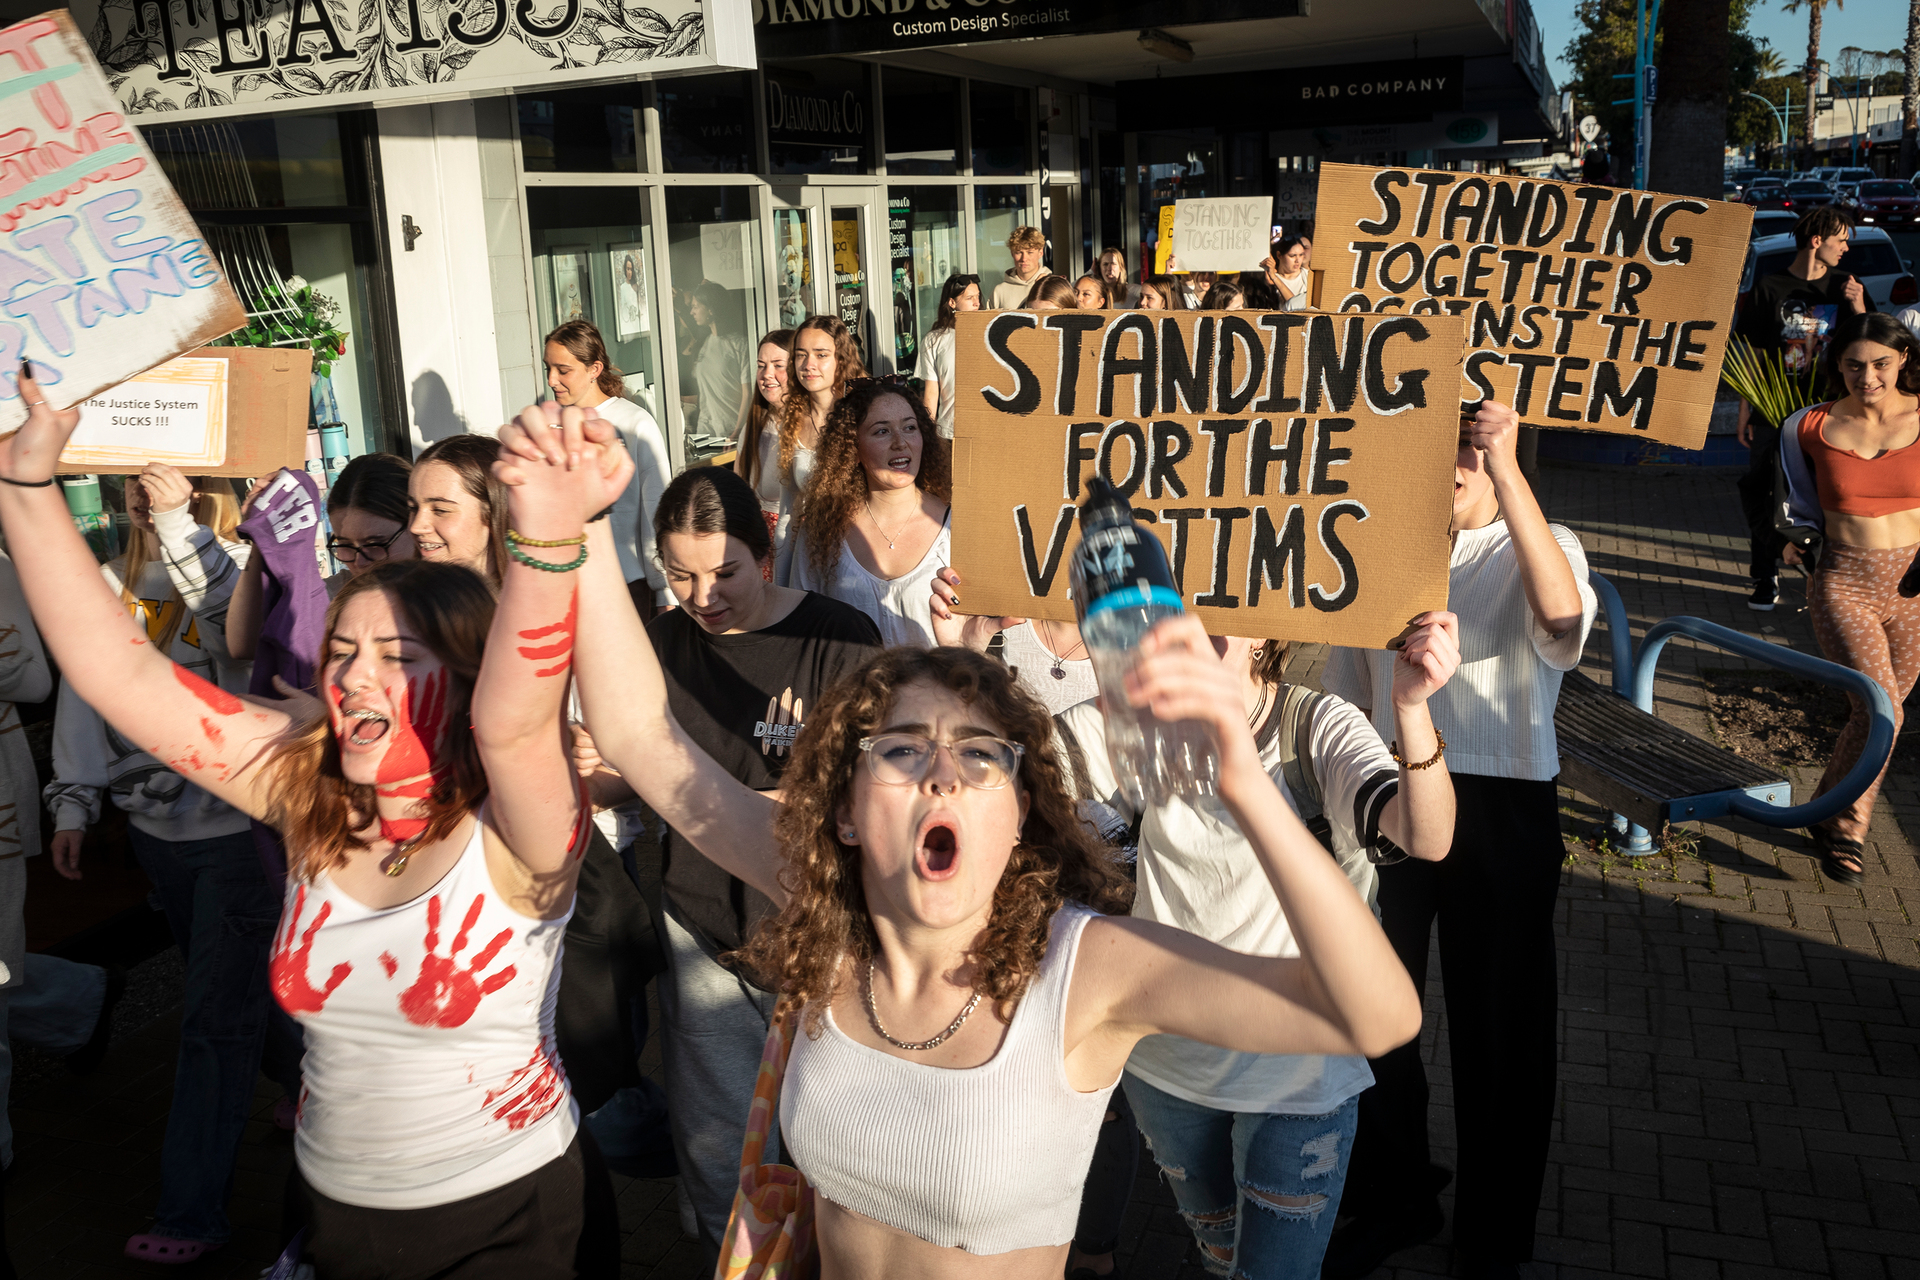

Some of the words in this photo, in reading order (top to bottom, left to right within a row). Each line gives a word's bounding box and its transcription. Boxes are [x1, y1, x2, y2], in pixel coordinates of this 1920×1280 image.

[893, 21, 946, 36] Custom
[950, 15, 998, 32] Design
[1001, 8, 1070, 29] Specialist
[1302, 85, 1339, 99] BAD
[1347, 77, 1446, 96] COMPANY
[768, 79, 830, 133] DIAMOND
[832, 101, 841, 133] &
[1453, 122, 1480, 139] 159
[1585, 122, 1597, 133] 37
[1183, 203, 1260, 227] STANDING
[1355, 169, 1709, 266] STANDING
[1185, 229, 1252, 251] TOGETHER
[1348, 241, 1653, 314] TOGETHER
[840, 293, 861, 307] Custom
[1597, 314, 1717, 371] THE
[980, 312, 1432, 417] STANDING
[109, 398, 151, 409] Justice
[154, 399, 199, 411] System
[111, 415, 152, 426] SUCKS
[155, 416, 169, 426] !!!
[1063, 419, 1193, 500] FOR
[1197, 417, 1356, 497] THE
[1013, 499, 1371, 613] VTIMS
